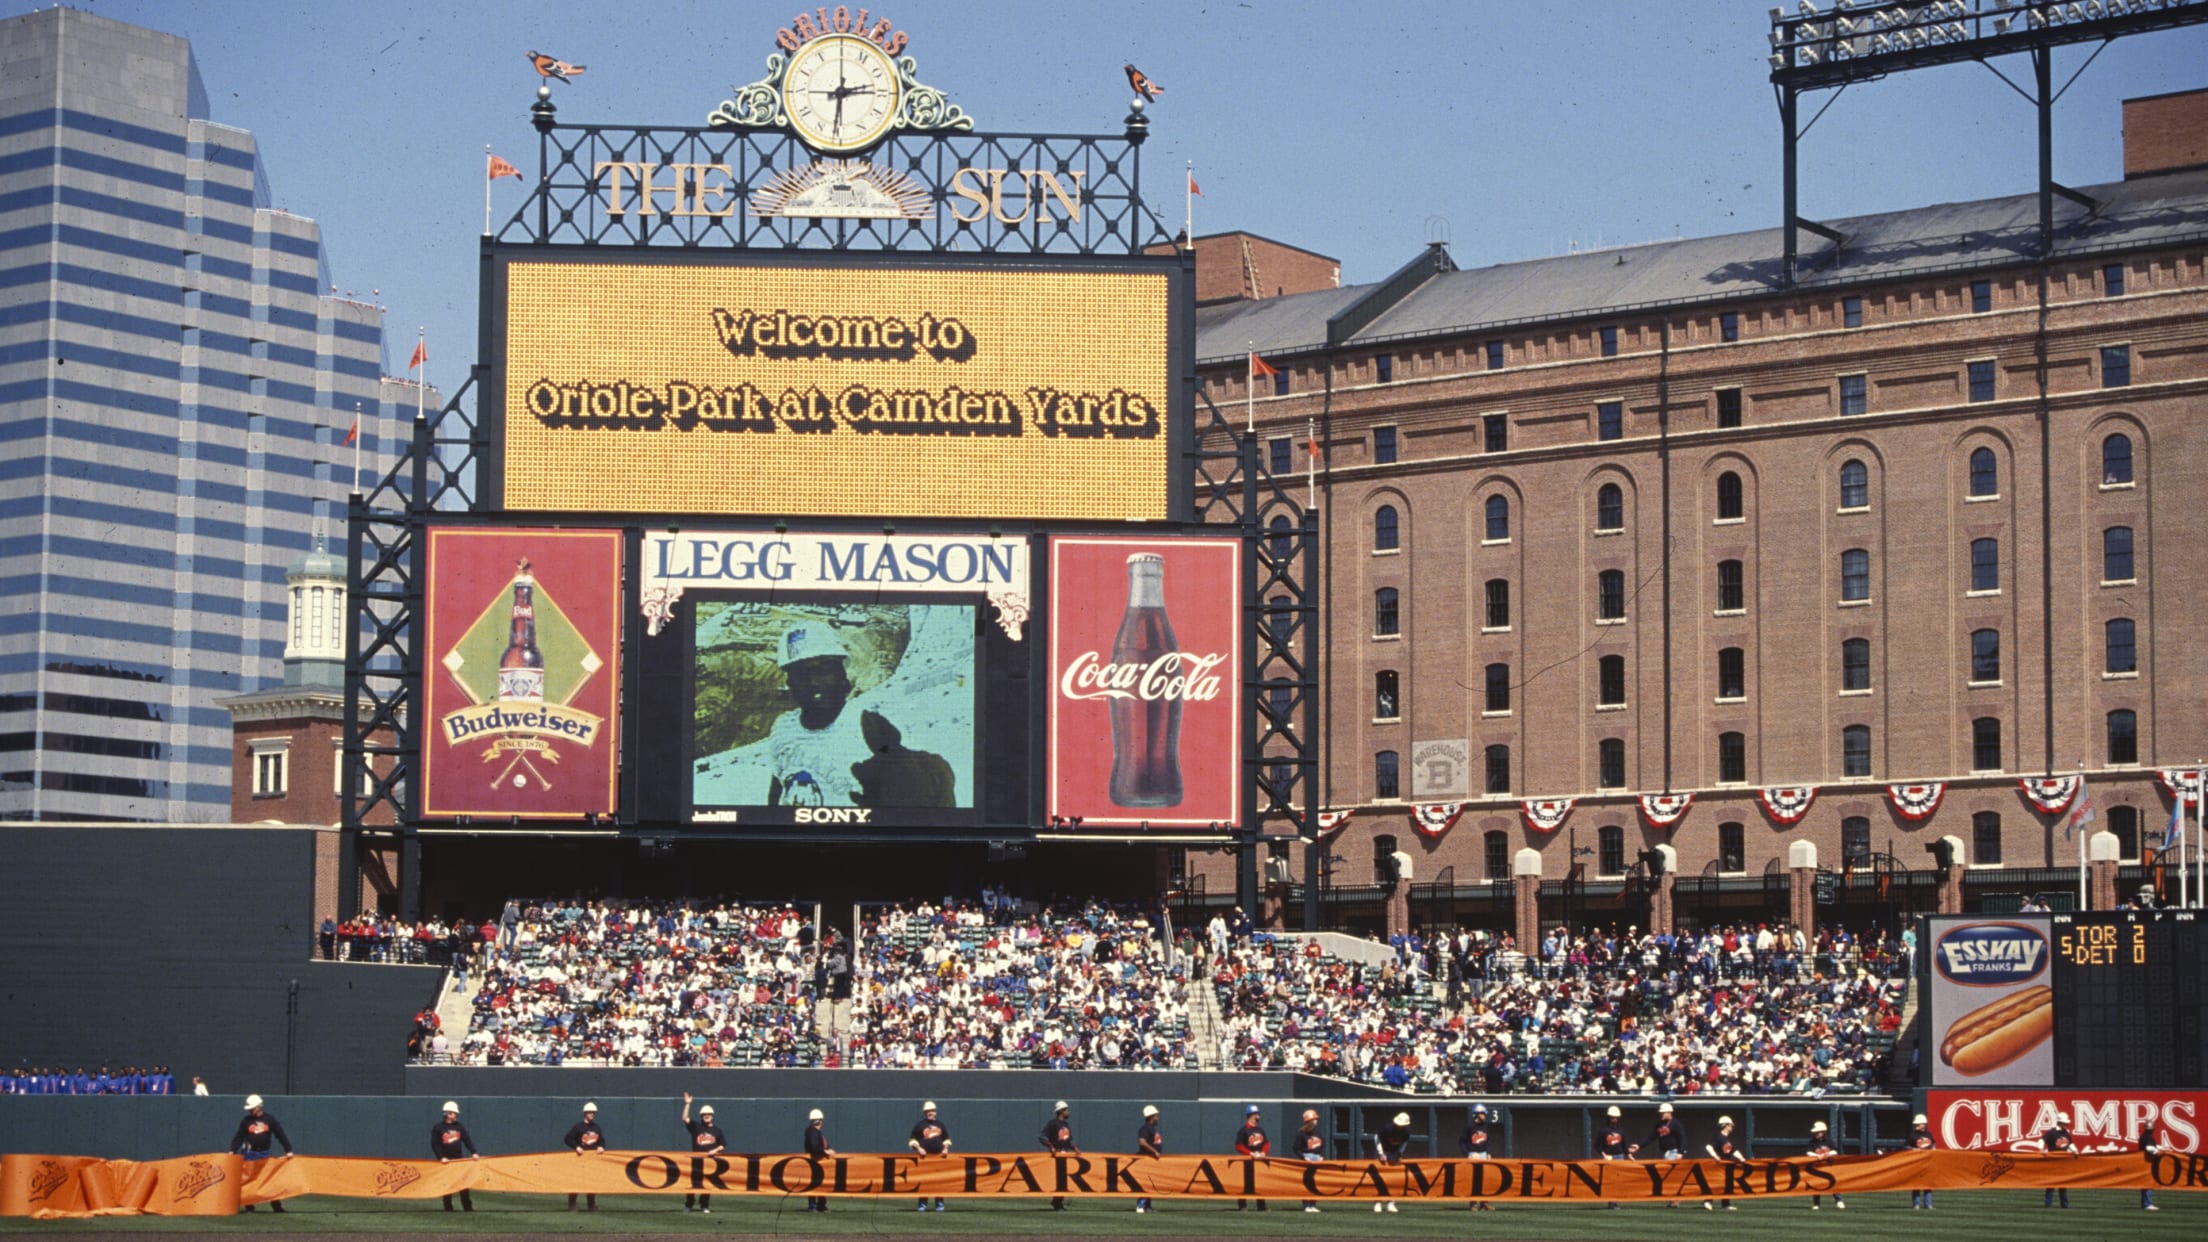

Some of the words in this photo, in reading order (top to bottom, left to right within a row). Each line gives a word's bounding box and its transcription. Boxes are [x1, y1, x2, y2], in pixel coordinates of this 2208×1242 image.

[776, 5, 909, 55] ORIOLES
[594, 162, 735, 217] THE
[951, 168, 1086, 224] SUN
[712, 308, 911, 353] Welcome
[918, 312, 970, 355] to
[526, 379, 660, 423] Oriole
[667, 381, 769, 425] Park
[776, 386, 829, 427] at
[837, 386, 1017, 429] Camden
[1025, 387, 1153, 431] Yards
[653, 539, 796, 581] LEGG
[815, 541, 1018, 584] MASON
[513, 606, 532, 616] Bud
[1061, 651, 1228, 700] Coca-Cola
[446, 707, 592, 739] Budweiser
[1426, 760, 1453, 790] B
[795, 808, 871, 823] SONY
[2054, 915, 2072, 923] INN
[2176, 912, 2195, 921] INN
[2061, 936, 2072, 954] 5
[2075, 925, 2117, 944] TOR
[2133, 925, 2144, 943] 2
[1942, 939, 2043, 973] ESSKAY
[1972, 963, 2012, 972] FRANKS
[2076, 945, 2117, 964] DET
[2133, 944, 2145, 963] 0
[1941, 1098, 2200, 1154] CHAMPS
[625, 1155, 920, 1193] ORIOLE
[963, 1156, 1147, 1193] PARK
[1184, 1158, 1270, 1195] AT
[1302, 1161, 1607, 1198] CAMDEN
[1642, 1160, 1837, 1197] YARDS
